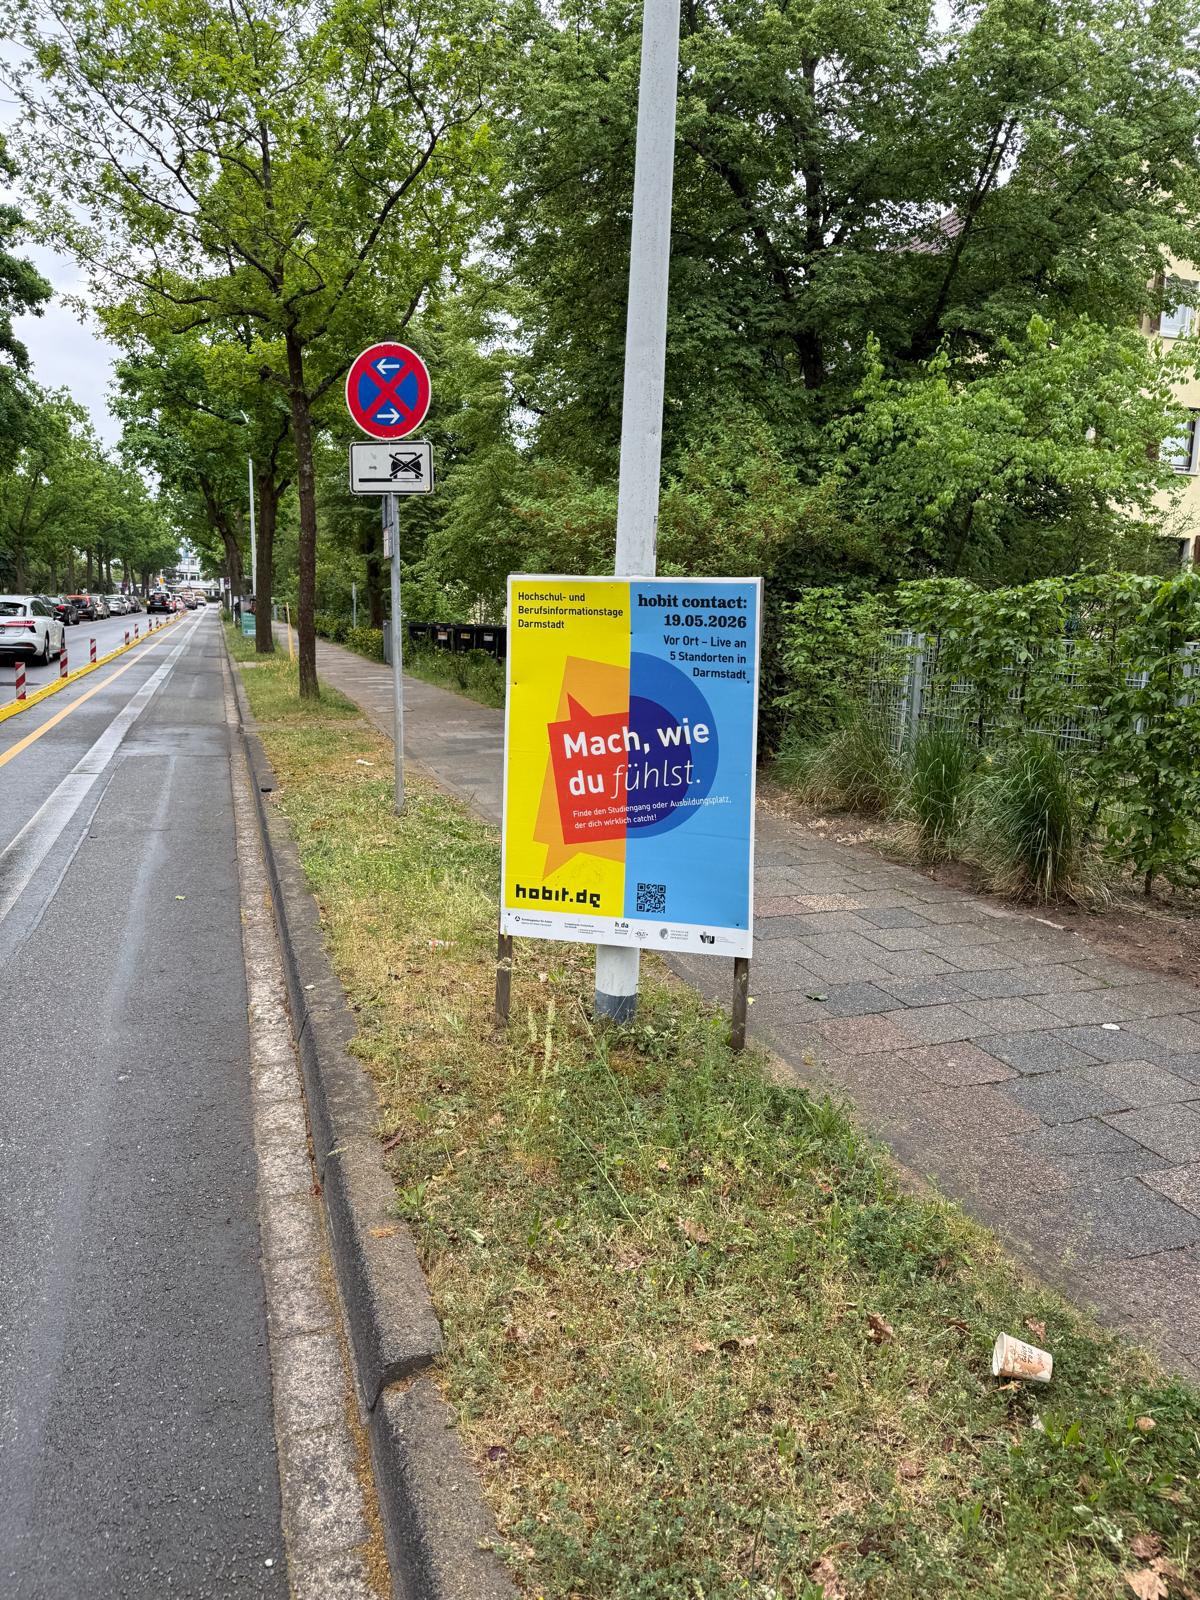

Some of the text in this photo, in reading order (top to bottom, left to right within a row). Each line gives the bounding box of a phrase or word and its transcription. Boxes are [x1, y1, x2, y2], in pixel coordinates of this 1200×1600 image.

[518, 592, 585, 601] Hochschul- und
[638, 594, 747, 609] hobit contact:
[518, 606, 624, 618] Berufsinformationstage
[518, 619, 565, 628] Darmstadt
[664, 614, 747, 628] 19.05.2026
[664, 635, 680, 646] Vor
[682, 635, 699, 646] Ort
[710, 636, 731, 648] Live
[734, 640, 747, 648] an
[670, 651, 747, 664] 5 Standorten in
[693, 667, 746, 679] Darmstadt
[563, 717, 710, 760] Mach, wie
[569, 759, 701, 800] du fühlst.
[573, 810, 592, 818] Finde
[607, 804, 651, 814] Studiengang
[652, 801, 668, 809] oder
[670, 796, 732, 807] Ausbildungsplatz,
[574, 813, 657, 829] der dich wirklich catcht!
[515, 884, 600, 908] hobit.de
